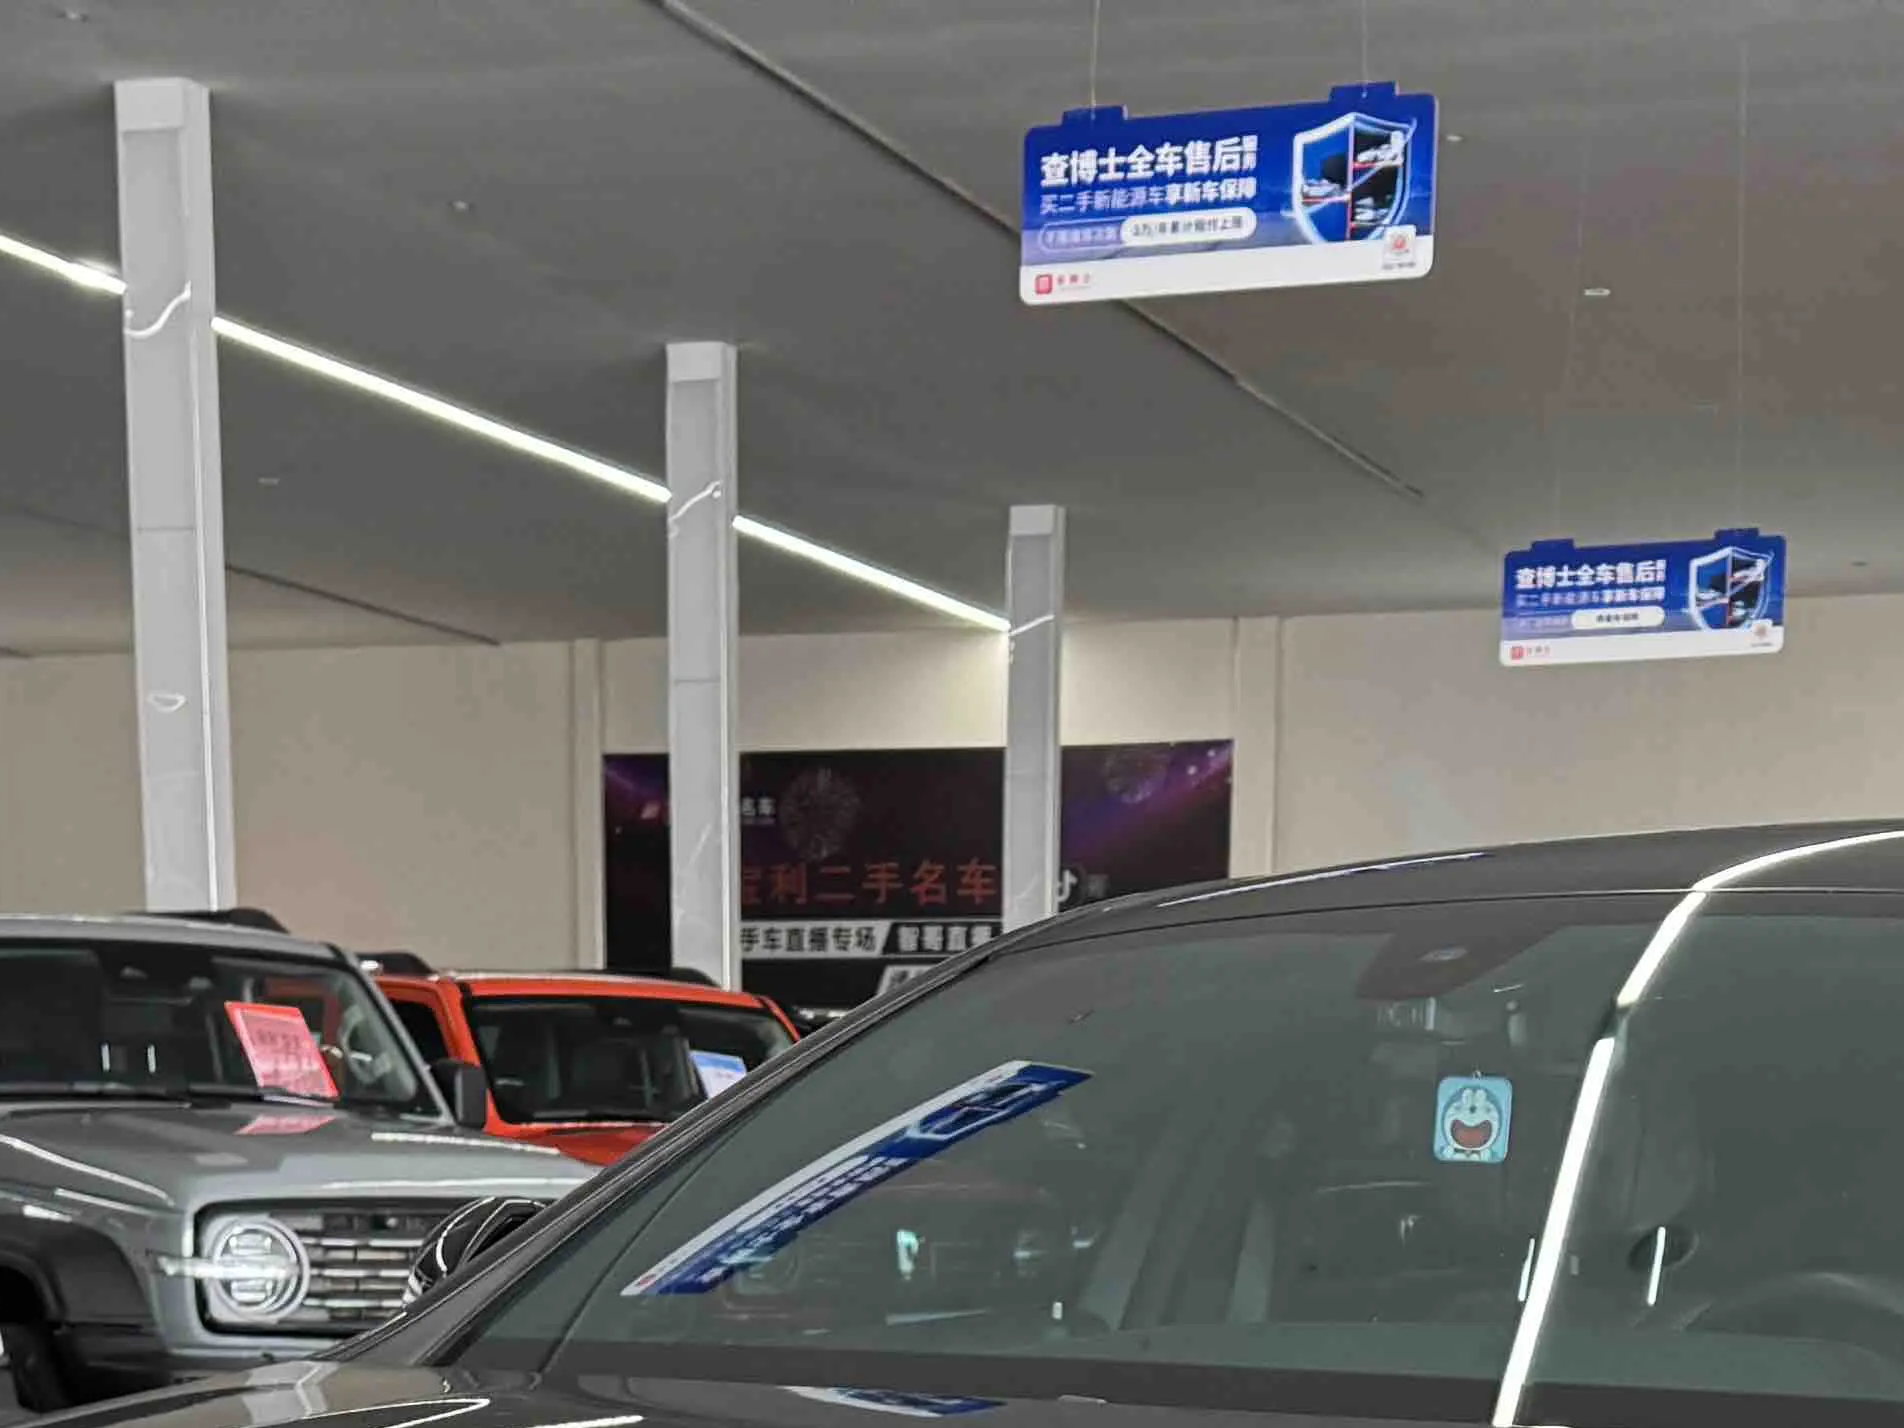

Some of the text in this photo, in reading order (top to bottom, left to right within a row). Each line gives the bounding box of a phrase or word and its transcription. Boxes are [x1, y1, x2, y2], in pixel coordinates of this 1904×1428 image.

[1039, 136, 1242, 188] 查博士全车售后
